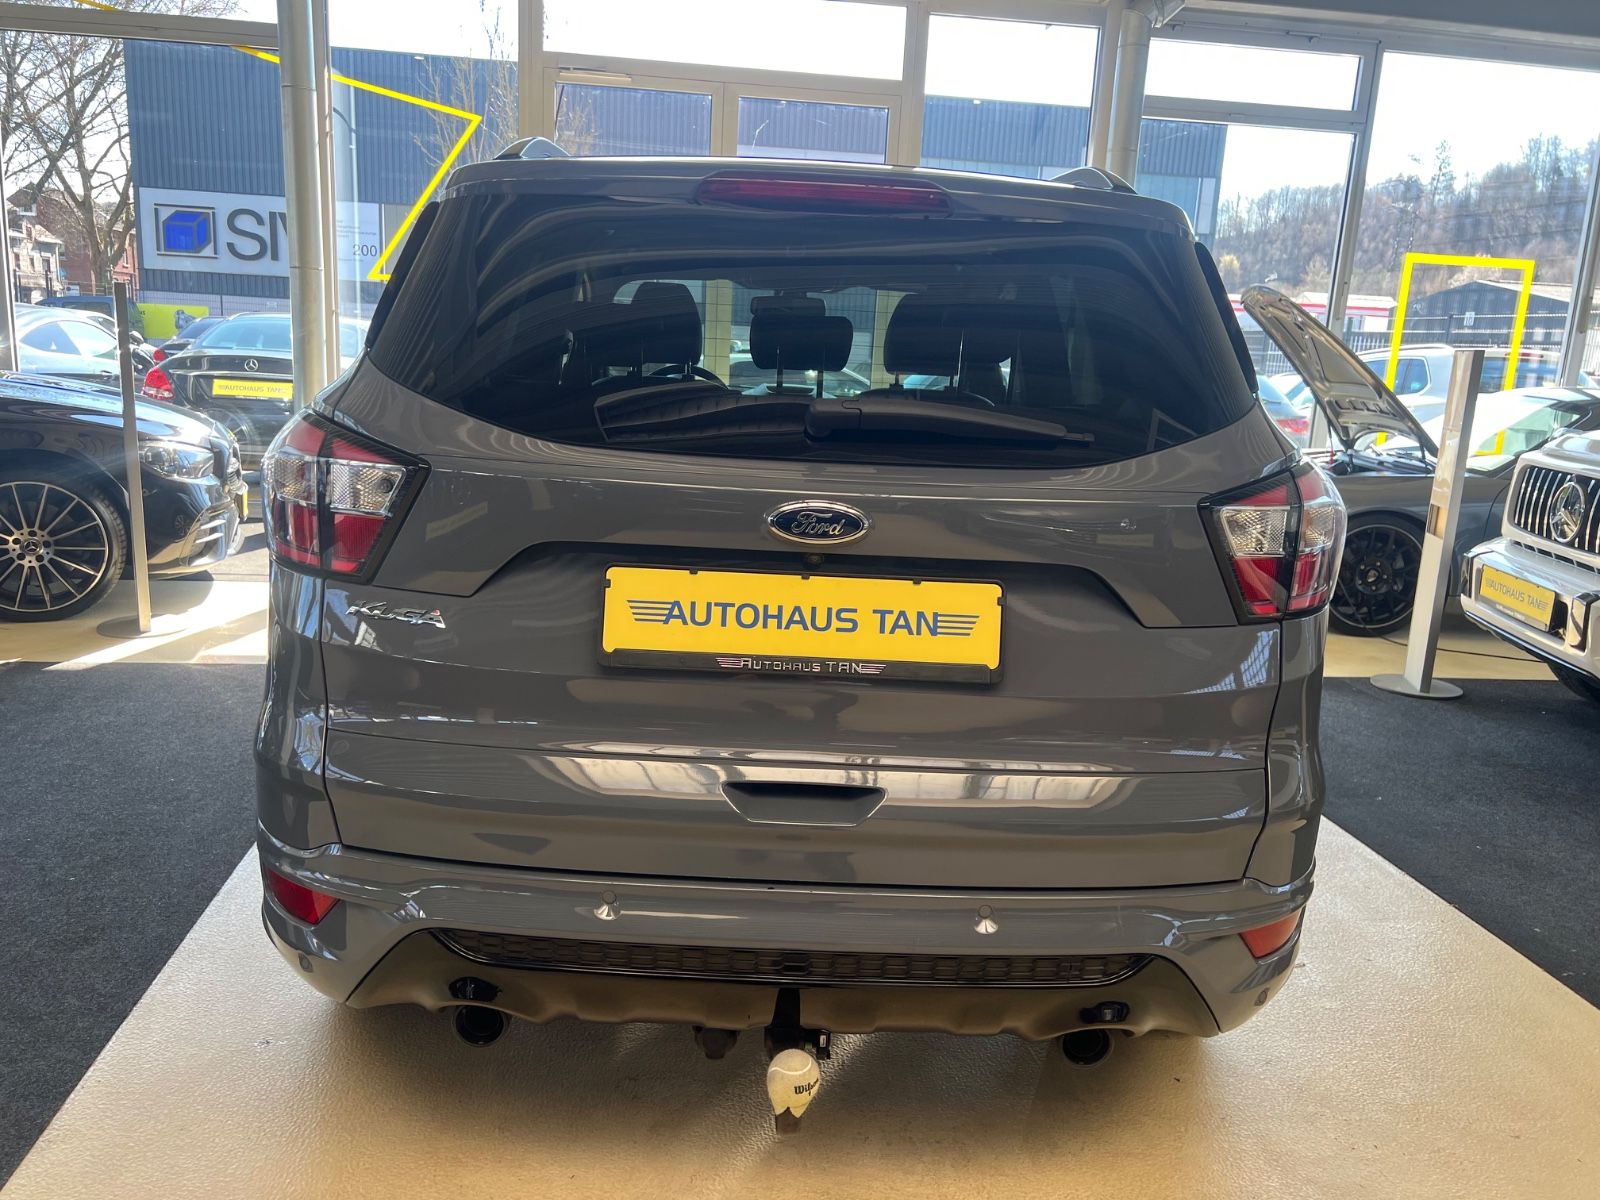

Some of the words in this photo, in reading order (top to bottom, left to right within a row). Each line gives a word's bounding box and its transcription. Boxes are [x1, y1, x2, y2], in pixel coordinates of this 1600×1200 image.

[791, 511, 846, 534] Ford
[1489, 580, 1526, 602] AUTOHAUS
[1527, 594, 1541, 609] TAN
[662, 600, 858, 633] AUTOHAUS
[872, 609, 938, 637] TAN
[825, 661, 862, 675] TAN
